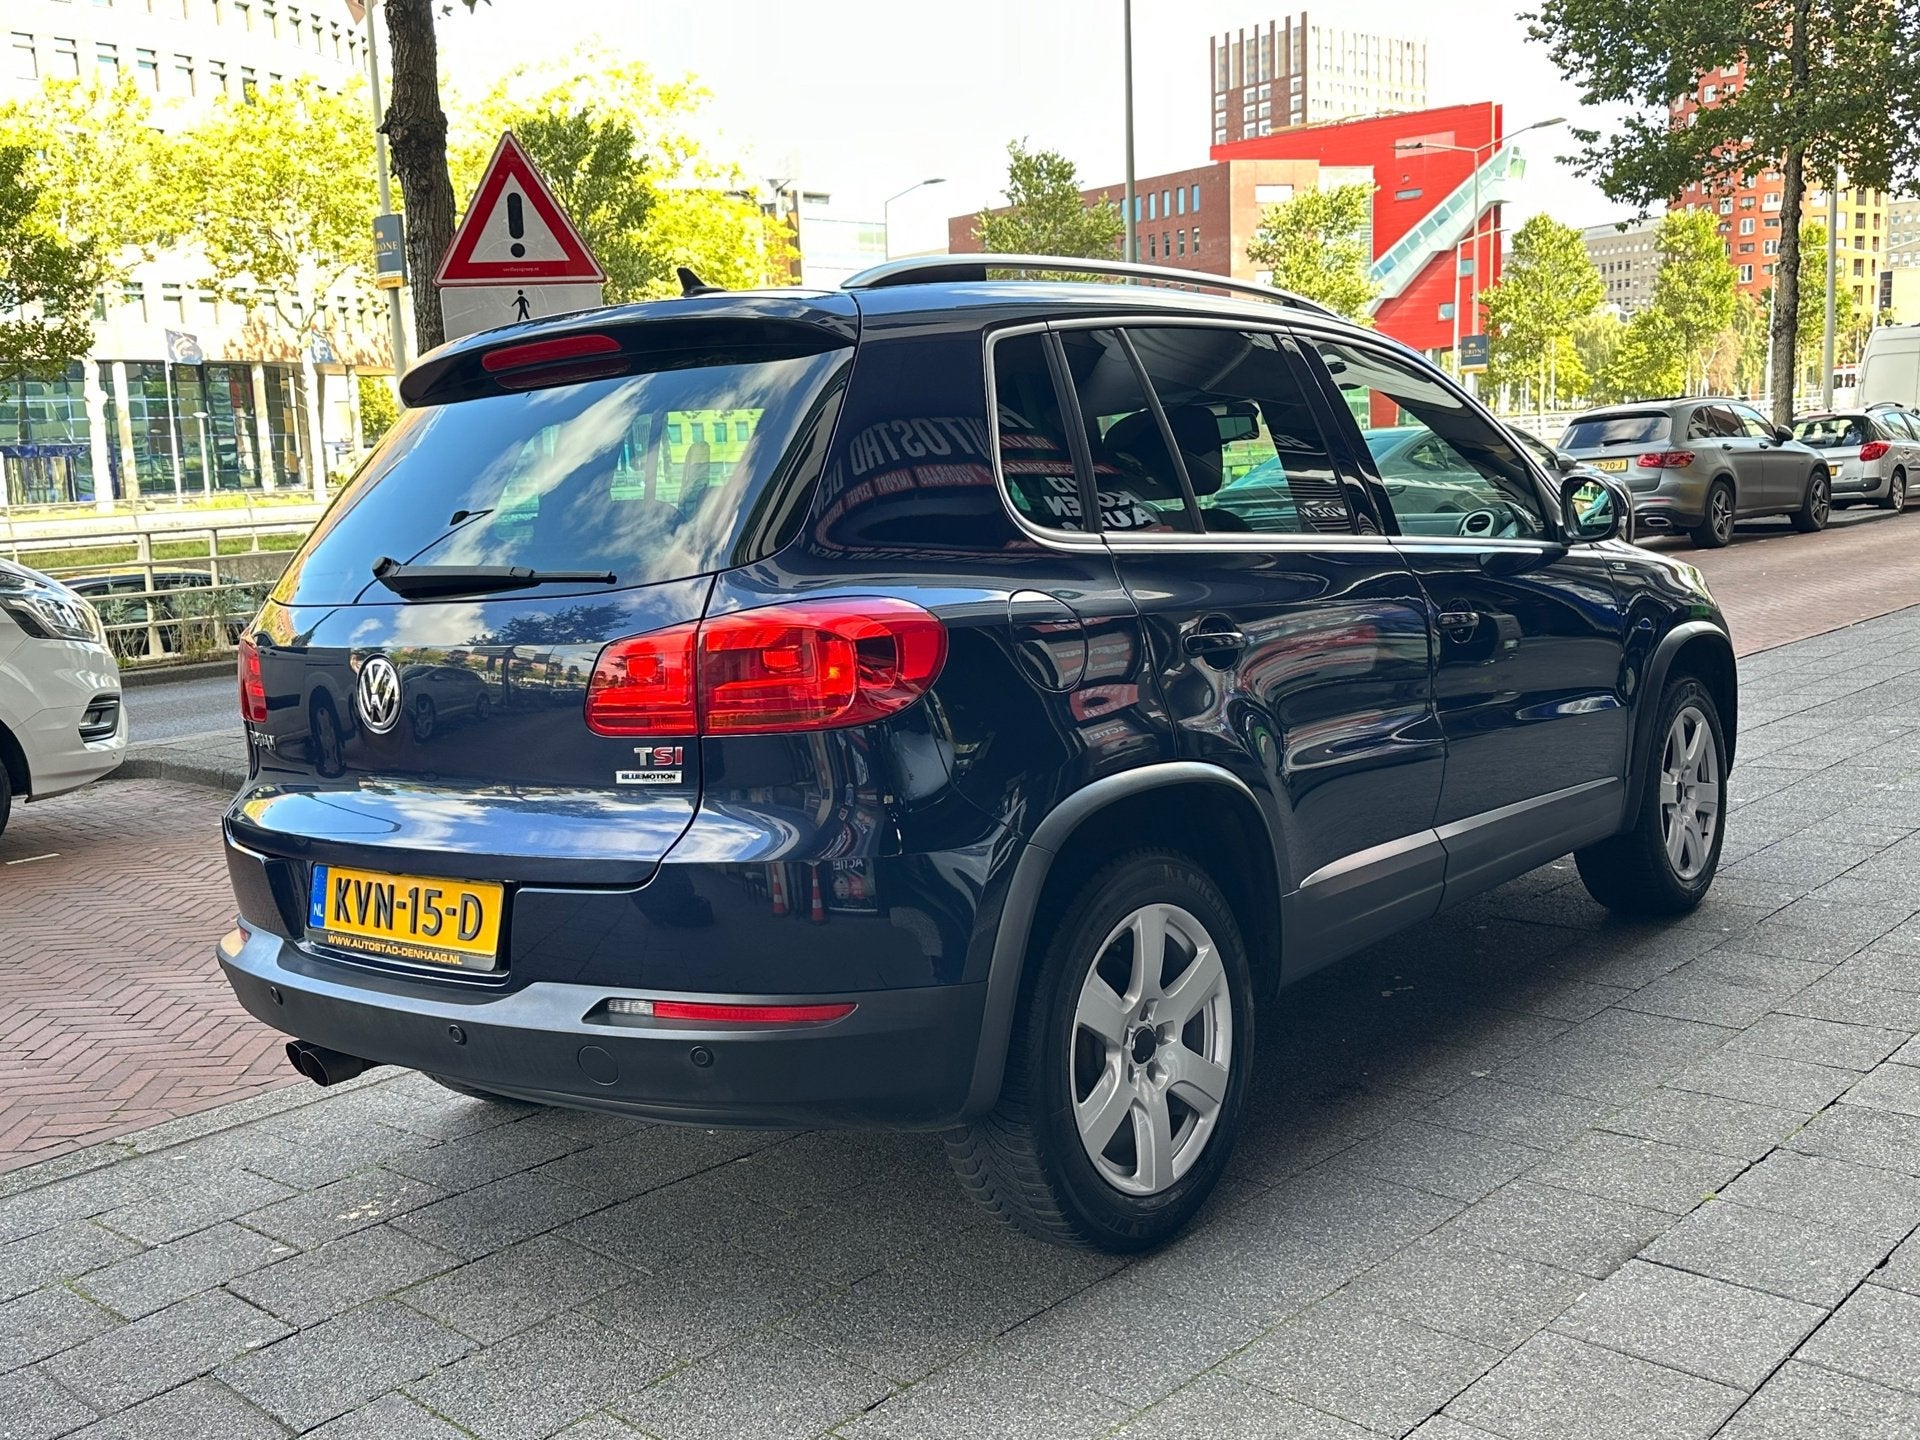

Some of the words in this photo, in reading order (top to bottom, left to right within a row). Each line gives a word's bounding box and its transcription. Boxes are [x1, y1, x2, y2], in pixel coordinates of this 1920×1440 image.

[633, 746, 684, 767] TSI
[313, 903, 324, 918] NL
[334, 876, 484, 942] KVN-15-D
[327, 935, 463, 966] WWW.AUTOSTAD-DENHAAG.NL
